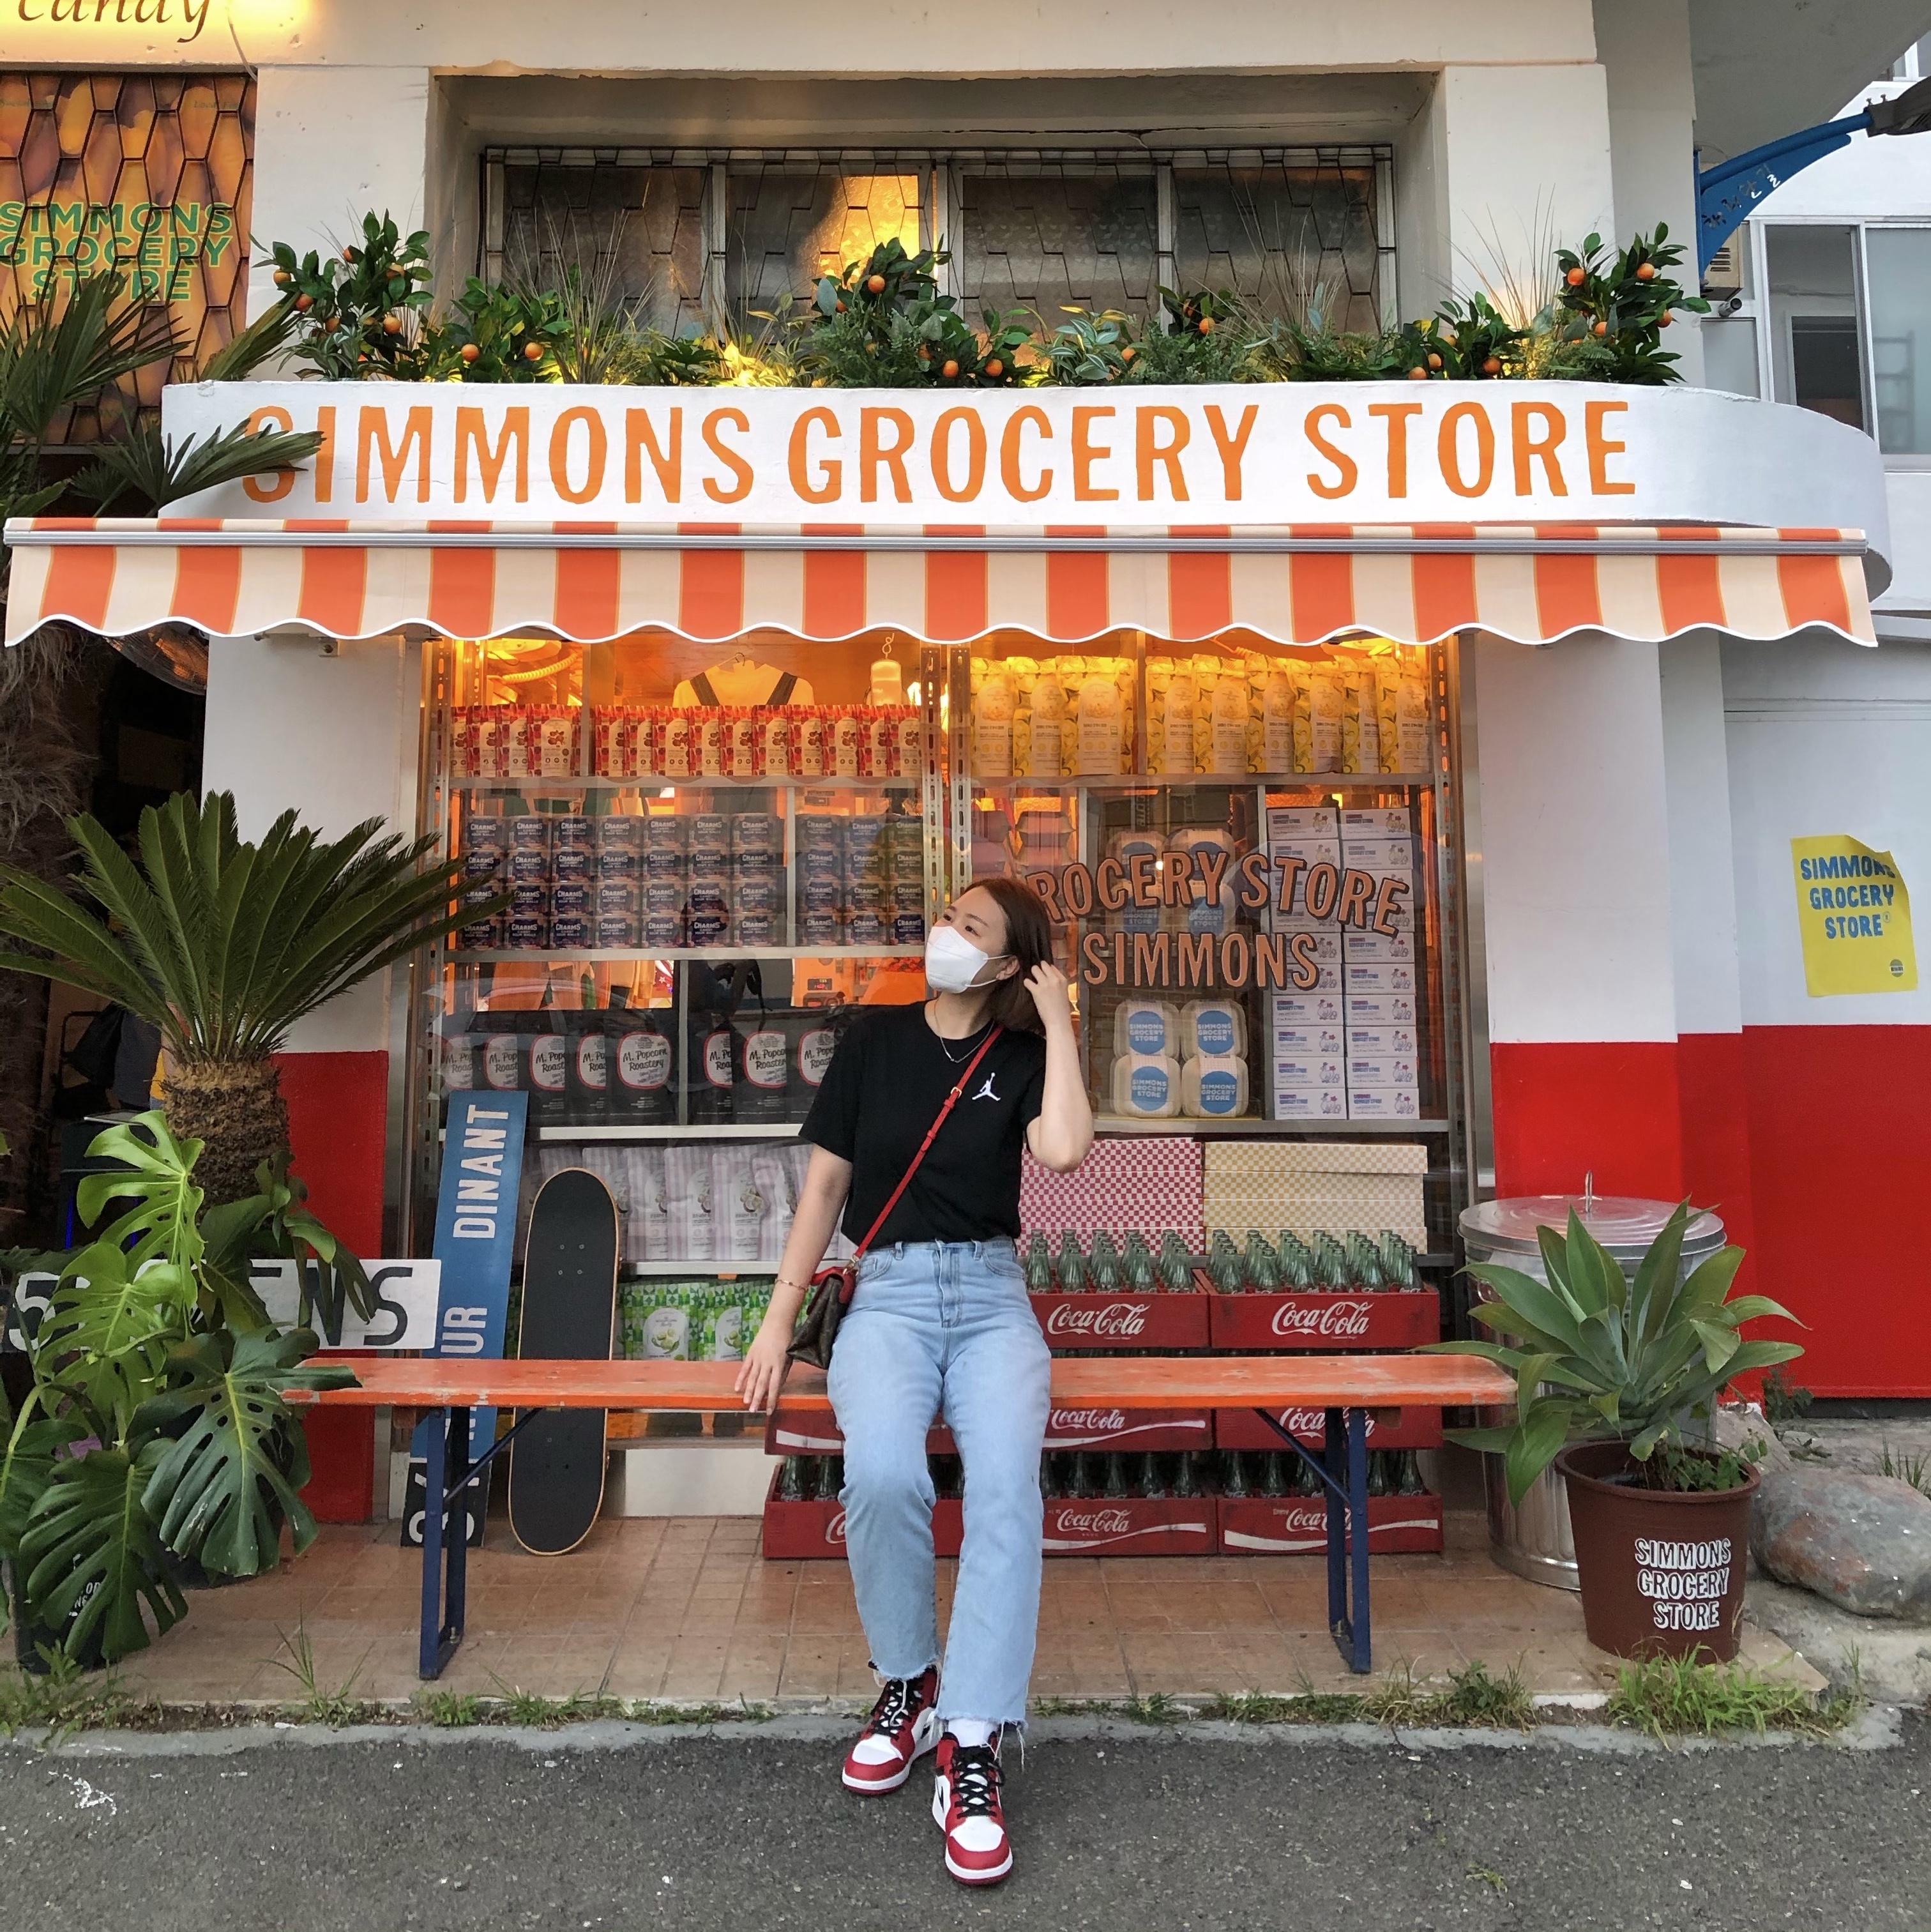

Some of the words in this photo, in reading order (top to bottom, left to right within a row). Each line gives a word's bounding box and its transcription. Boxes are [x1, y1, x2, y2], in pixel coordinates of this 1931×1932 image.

[0, 202, 234, 234] SIMMONS
[0, 236, 232, 268] GROCERY
[241, 406, 753, 505] SIMMONS
[788, 405, 1259, 504] GROCERY
[1304, 401, 1635, 499] STORE
[1025, 851, 1230, 924] ROCERY
[1241, 853, 1409, 938] STORE
[1810, 885, 1895, 909] GROCERY
[1084, 932, 1320, 991] SIMMONS
[628, 1059, 664, 1071] Roastery
[635, 1048, 667, 1060] Popcorn
[453, 1104, 509, 1238] DINANT
[1047, 1303, 1151, 1335] Coca-Cola
[1271, 1302, 1374, 1335] Coca-Cola
[1057, 1508, 1132, 1533] Coca-Cola
[1635, 1538, 1731, 1570] SIMMONS
[1637, 1567, 1729, 1600] GROCERY
[1653, 1601, 1720, 1631] STORE
